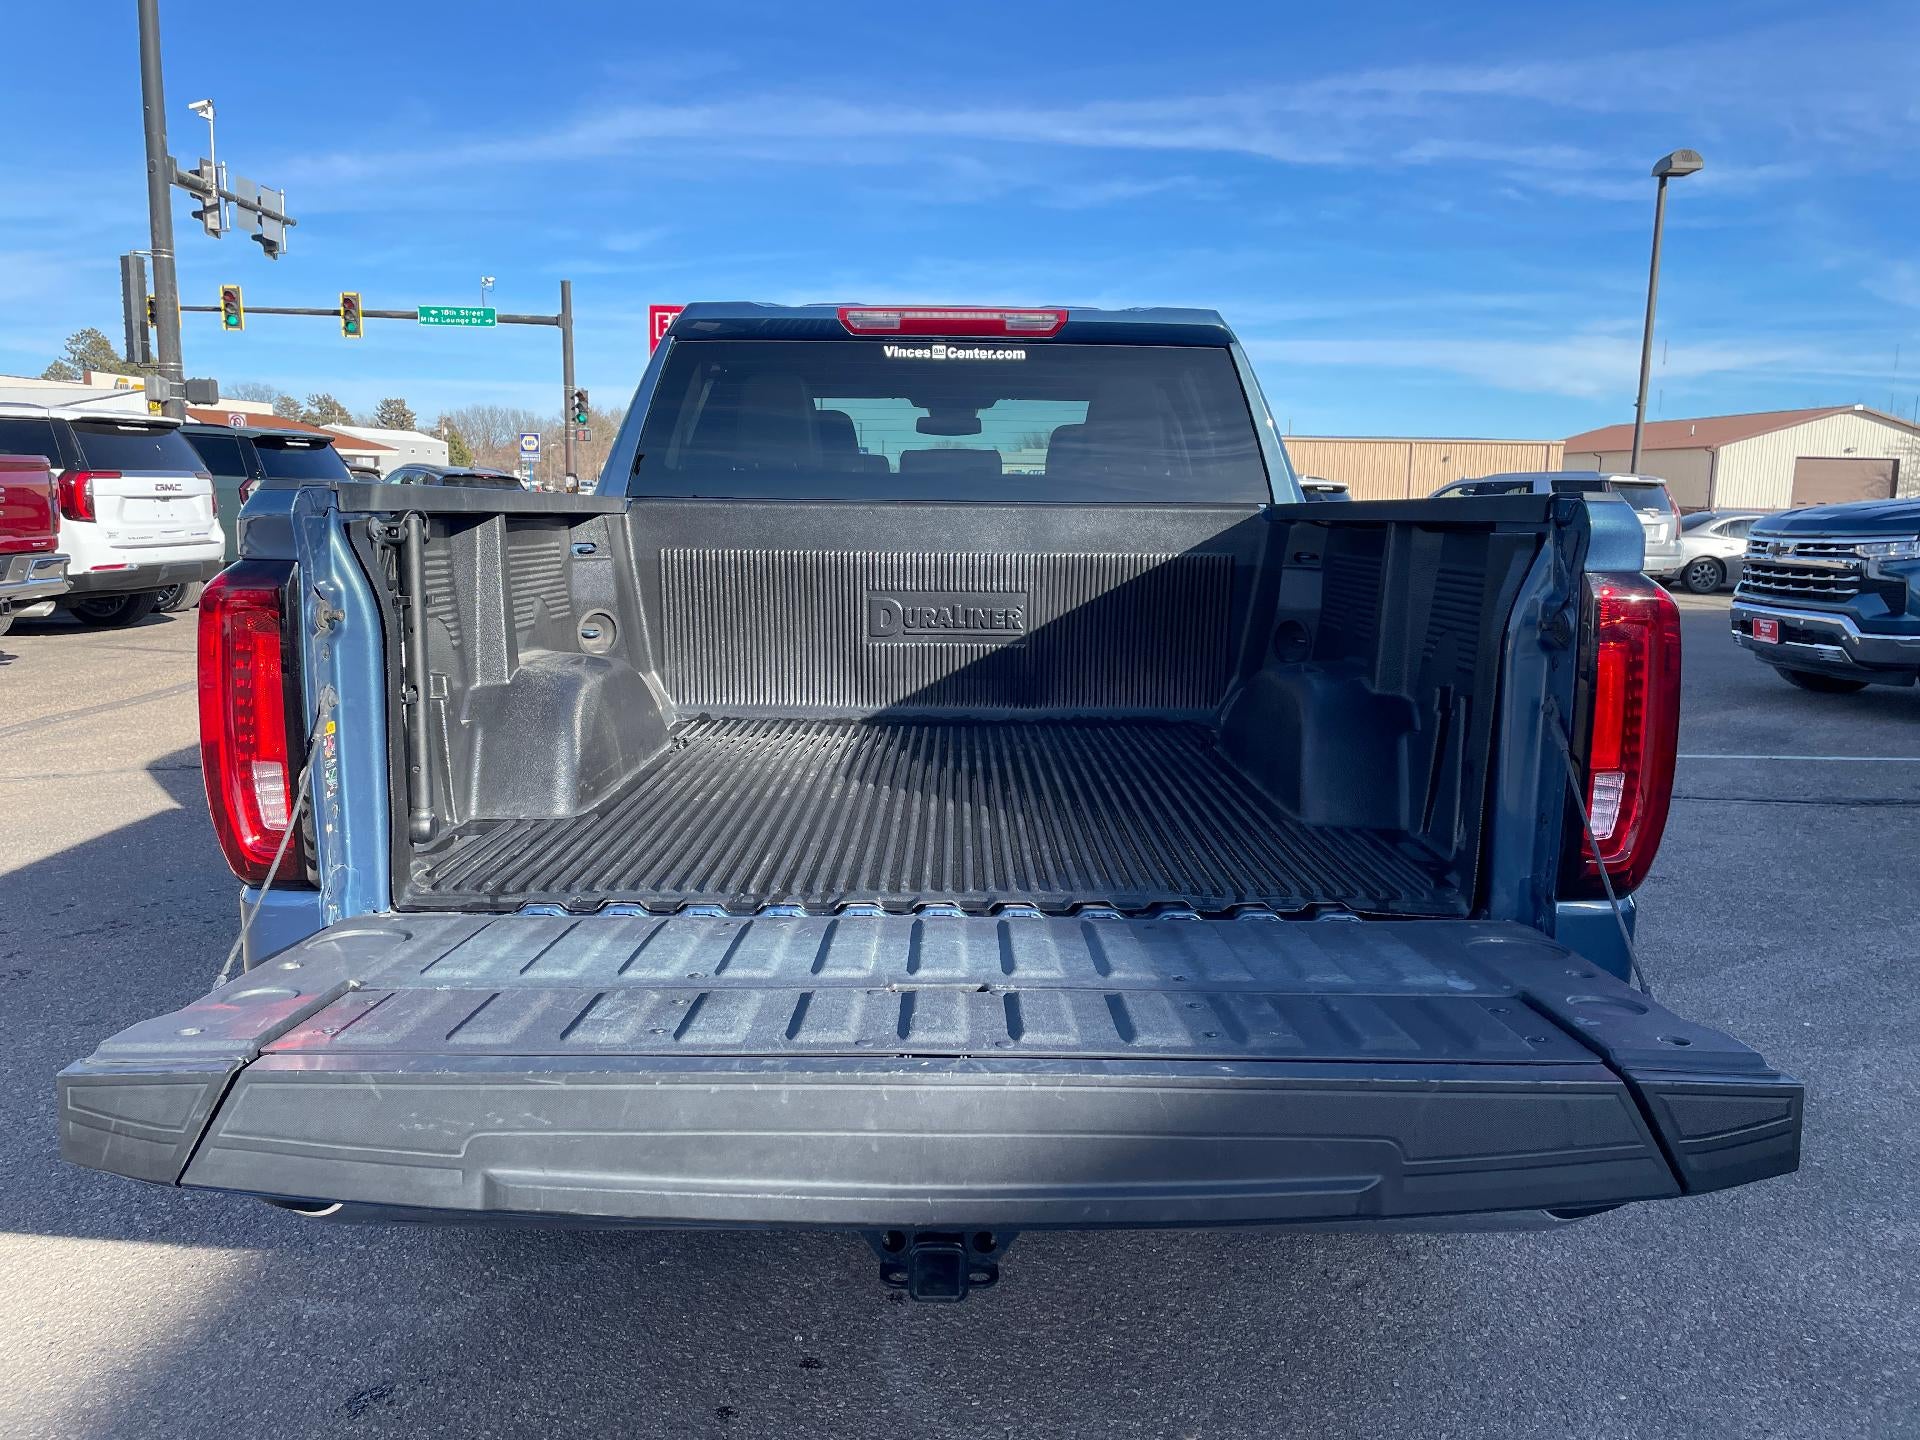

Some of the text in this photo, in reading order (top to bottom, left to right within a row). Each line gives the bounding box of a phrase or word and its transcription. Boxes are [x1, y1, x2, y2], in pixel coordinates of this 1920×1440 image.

[460, 309, 484, 317] Street
[441, 317, 469, 325] Lounge
[154, 483, 183, 491] GMC
